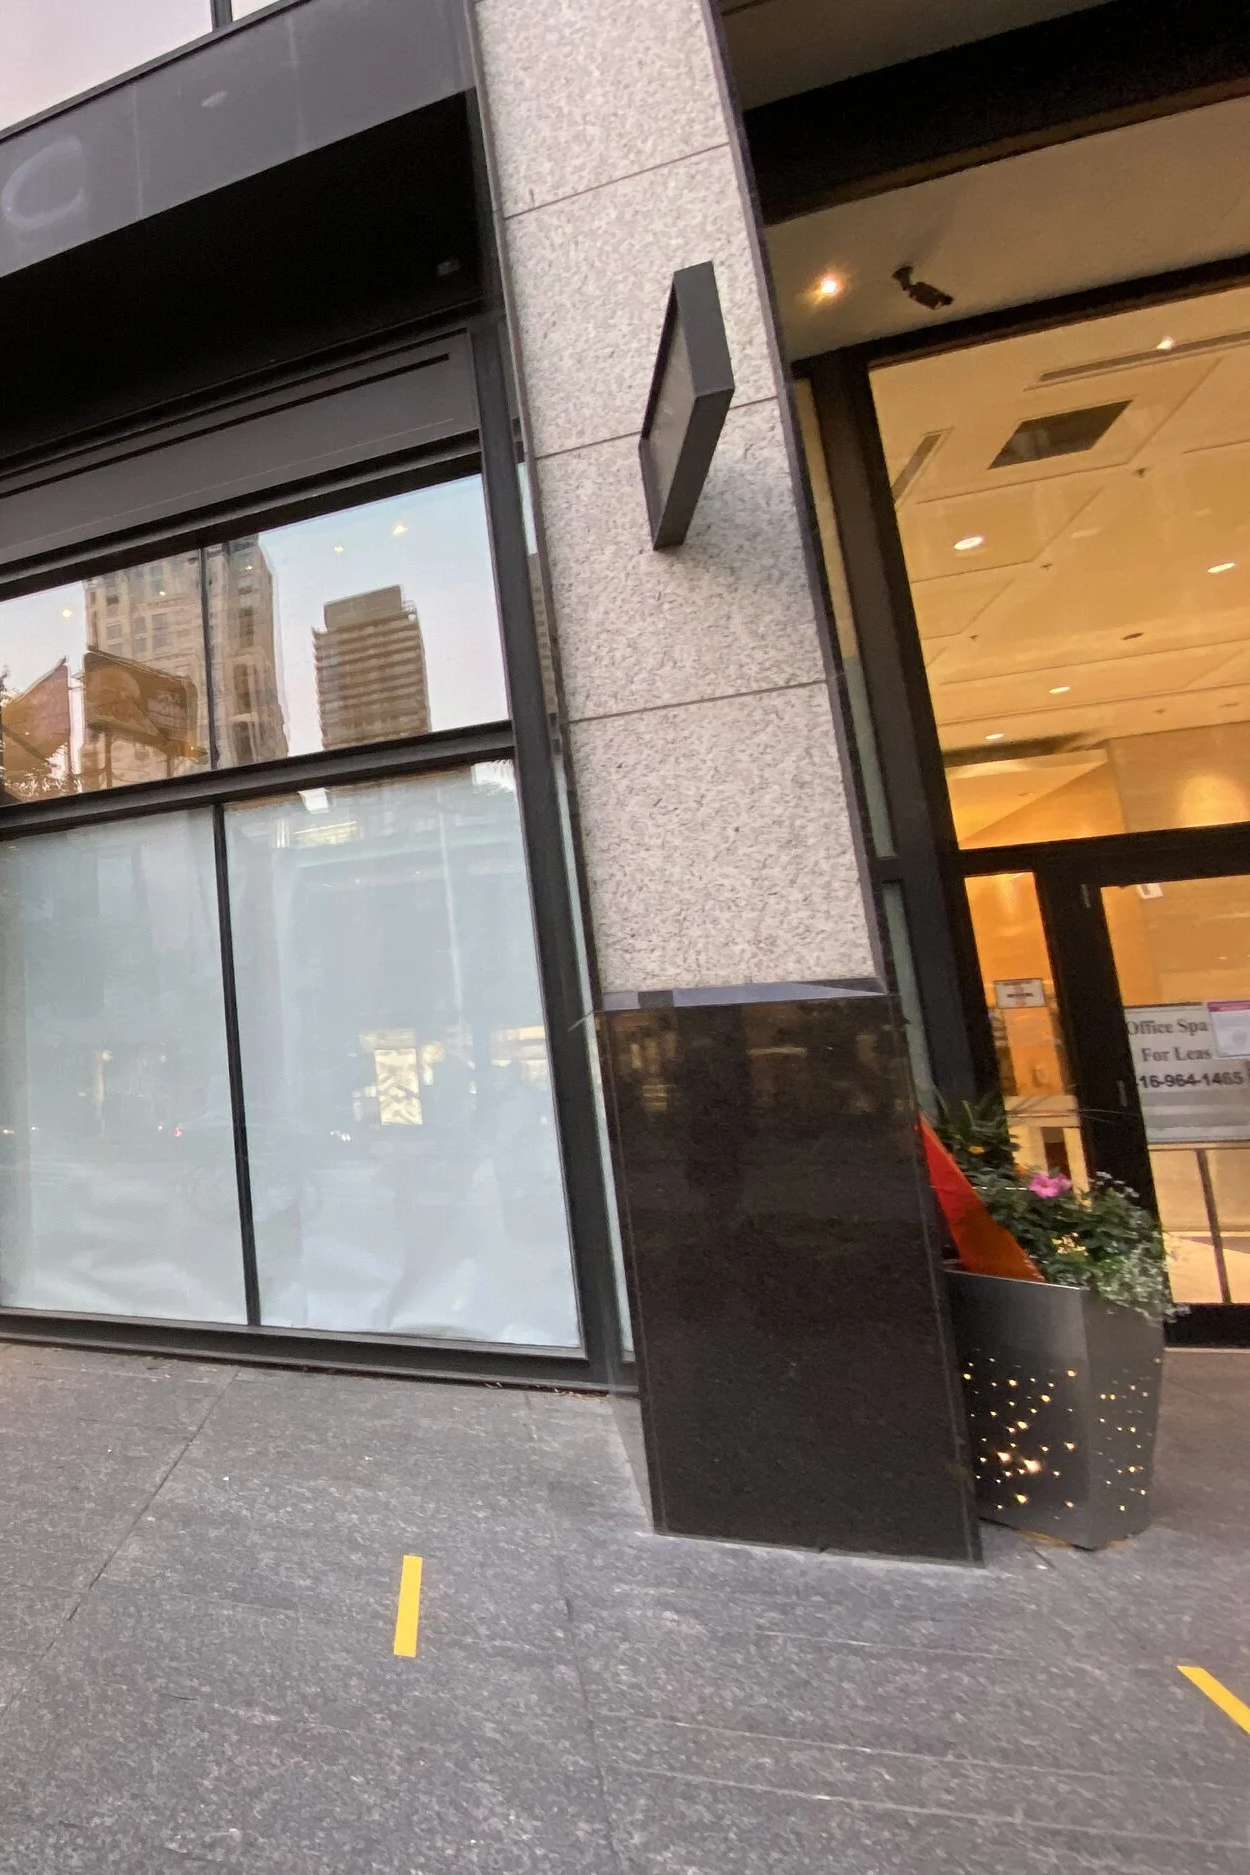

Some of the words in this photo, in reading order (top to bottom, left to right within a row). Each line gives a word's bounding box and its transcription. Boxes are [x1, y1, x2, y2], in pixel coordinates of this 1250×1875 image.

[1127, 1020, 1174, 1036] Office
[1176, 1018, 1210, 1037] Spa
[1140, 1047, 1170, 1062] For
[1173, 1046, 1213, 1062] Leas
[1137, 1071, 1244, 1089] 16-964-1465
